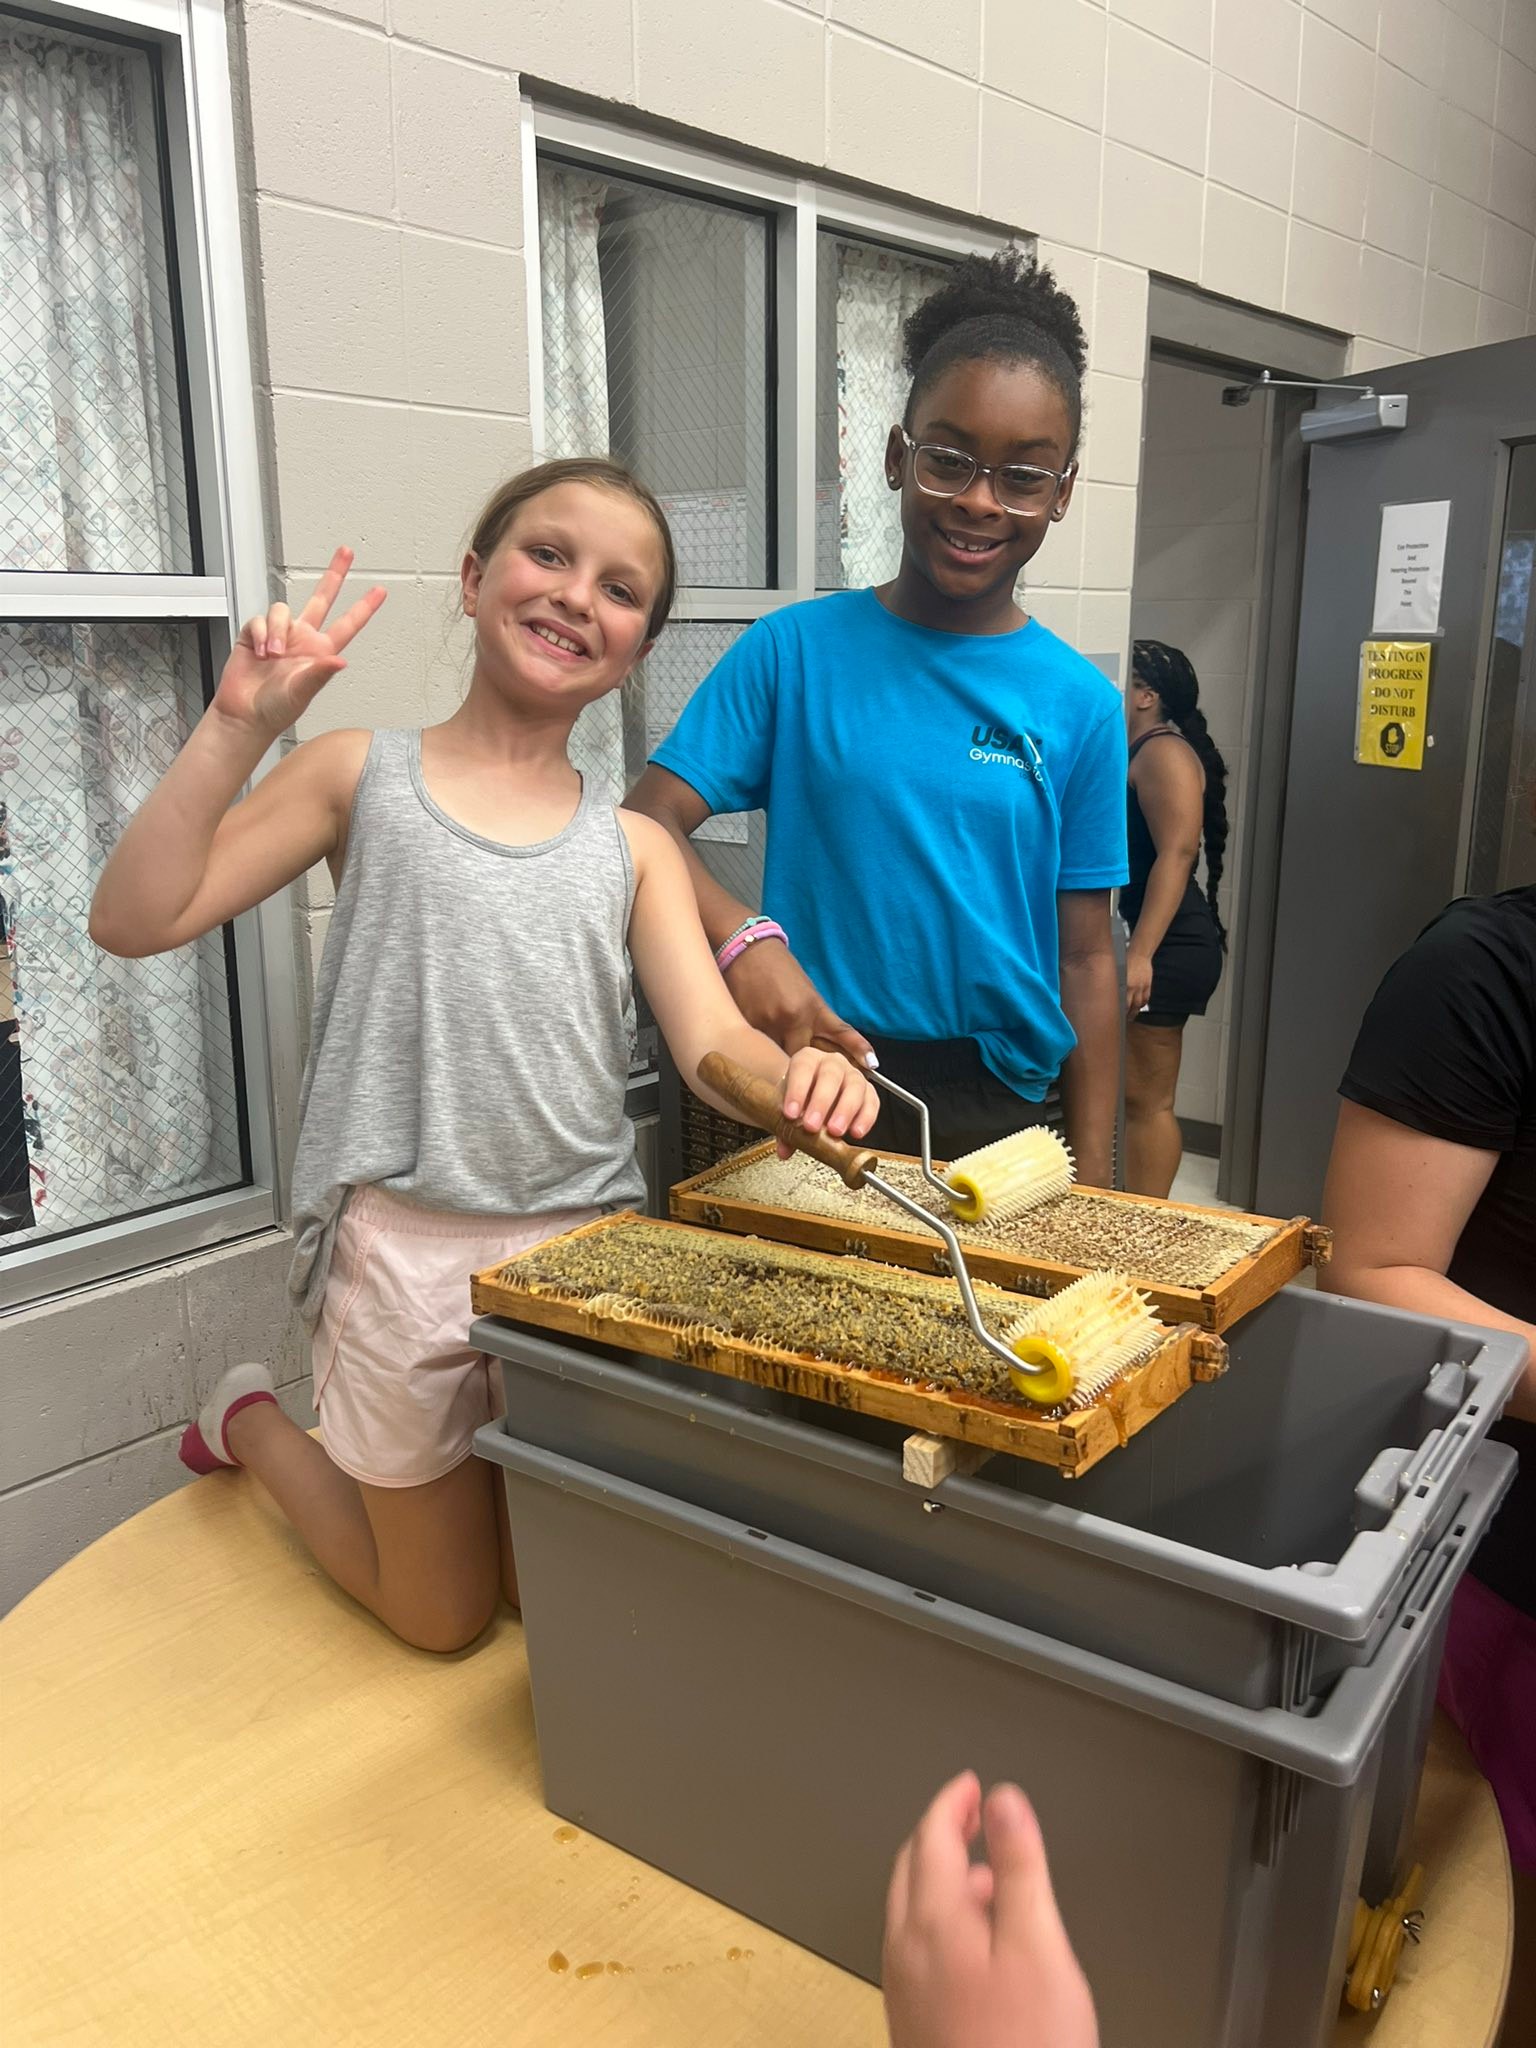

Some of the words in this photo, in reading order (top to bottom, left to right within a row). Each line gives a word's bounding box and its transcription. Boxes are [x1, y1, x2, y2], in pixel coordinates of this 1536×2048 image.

[1368, 650, 1413, 662] TESTING
[1413, 651, 1426, 663] IN
[1368, 668, 1423, 680] PROGRESS
[1375, 687, 1391, 698] DO
[1393, 688, 1415, 699] NOT
[1370, 704, 1416, 717] DISTURB
[971, 725, 1024, 751] USA
